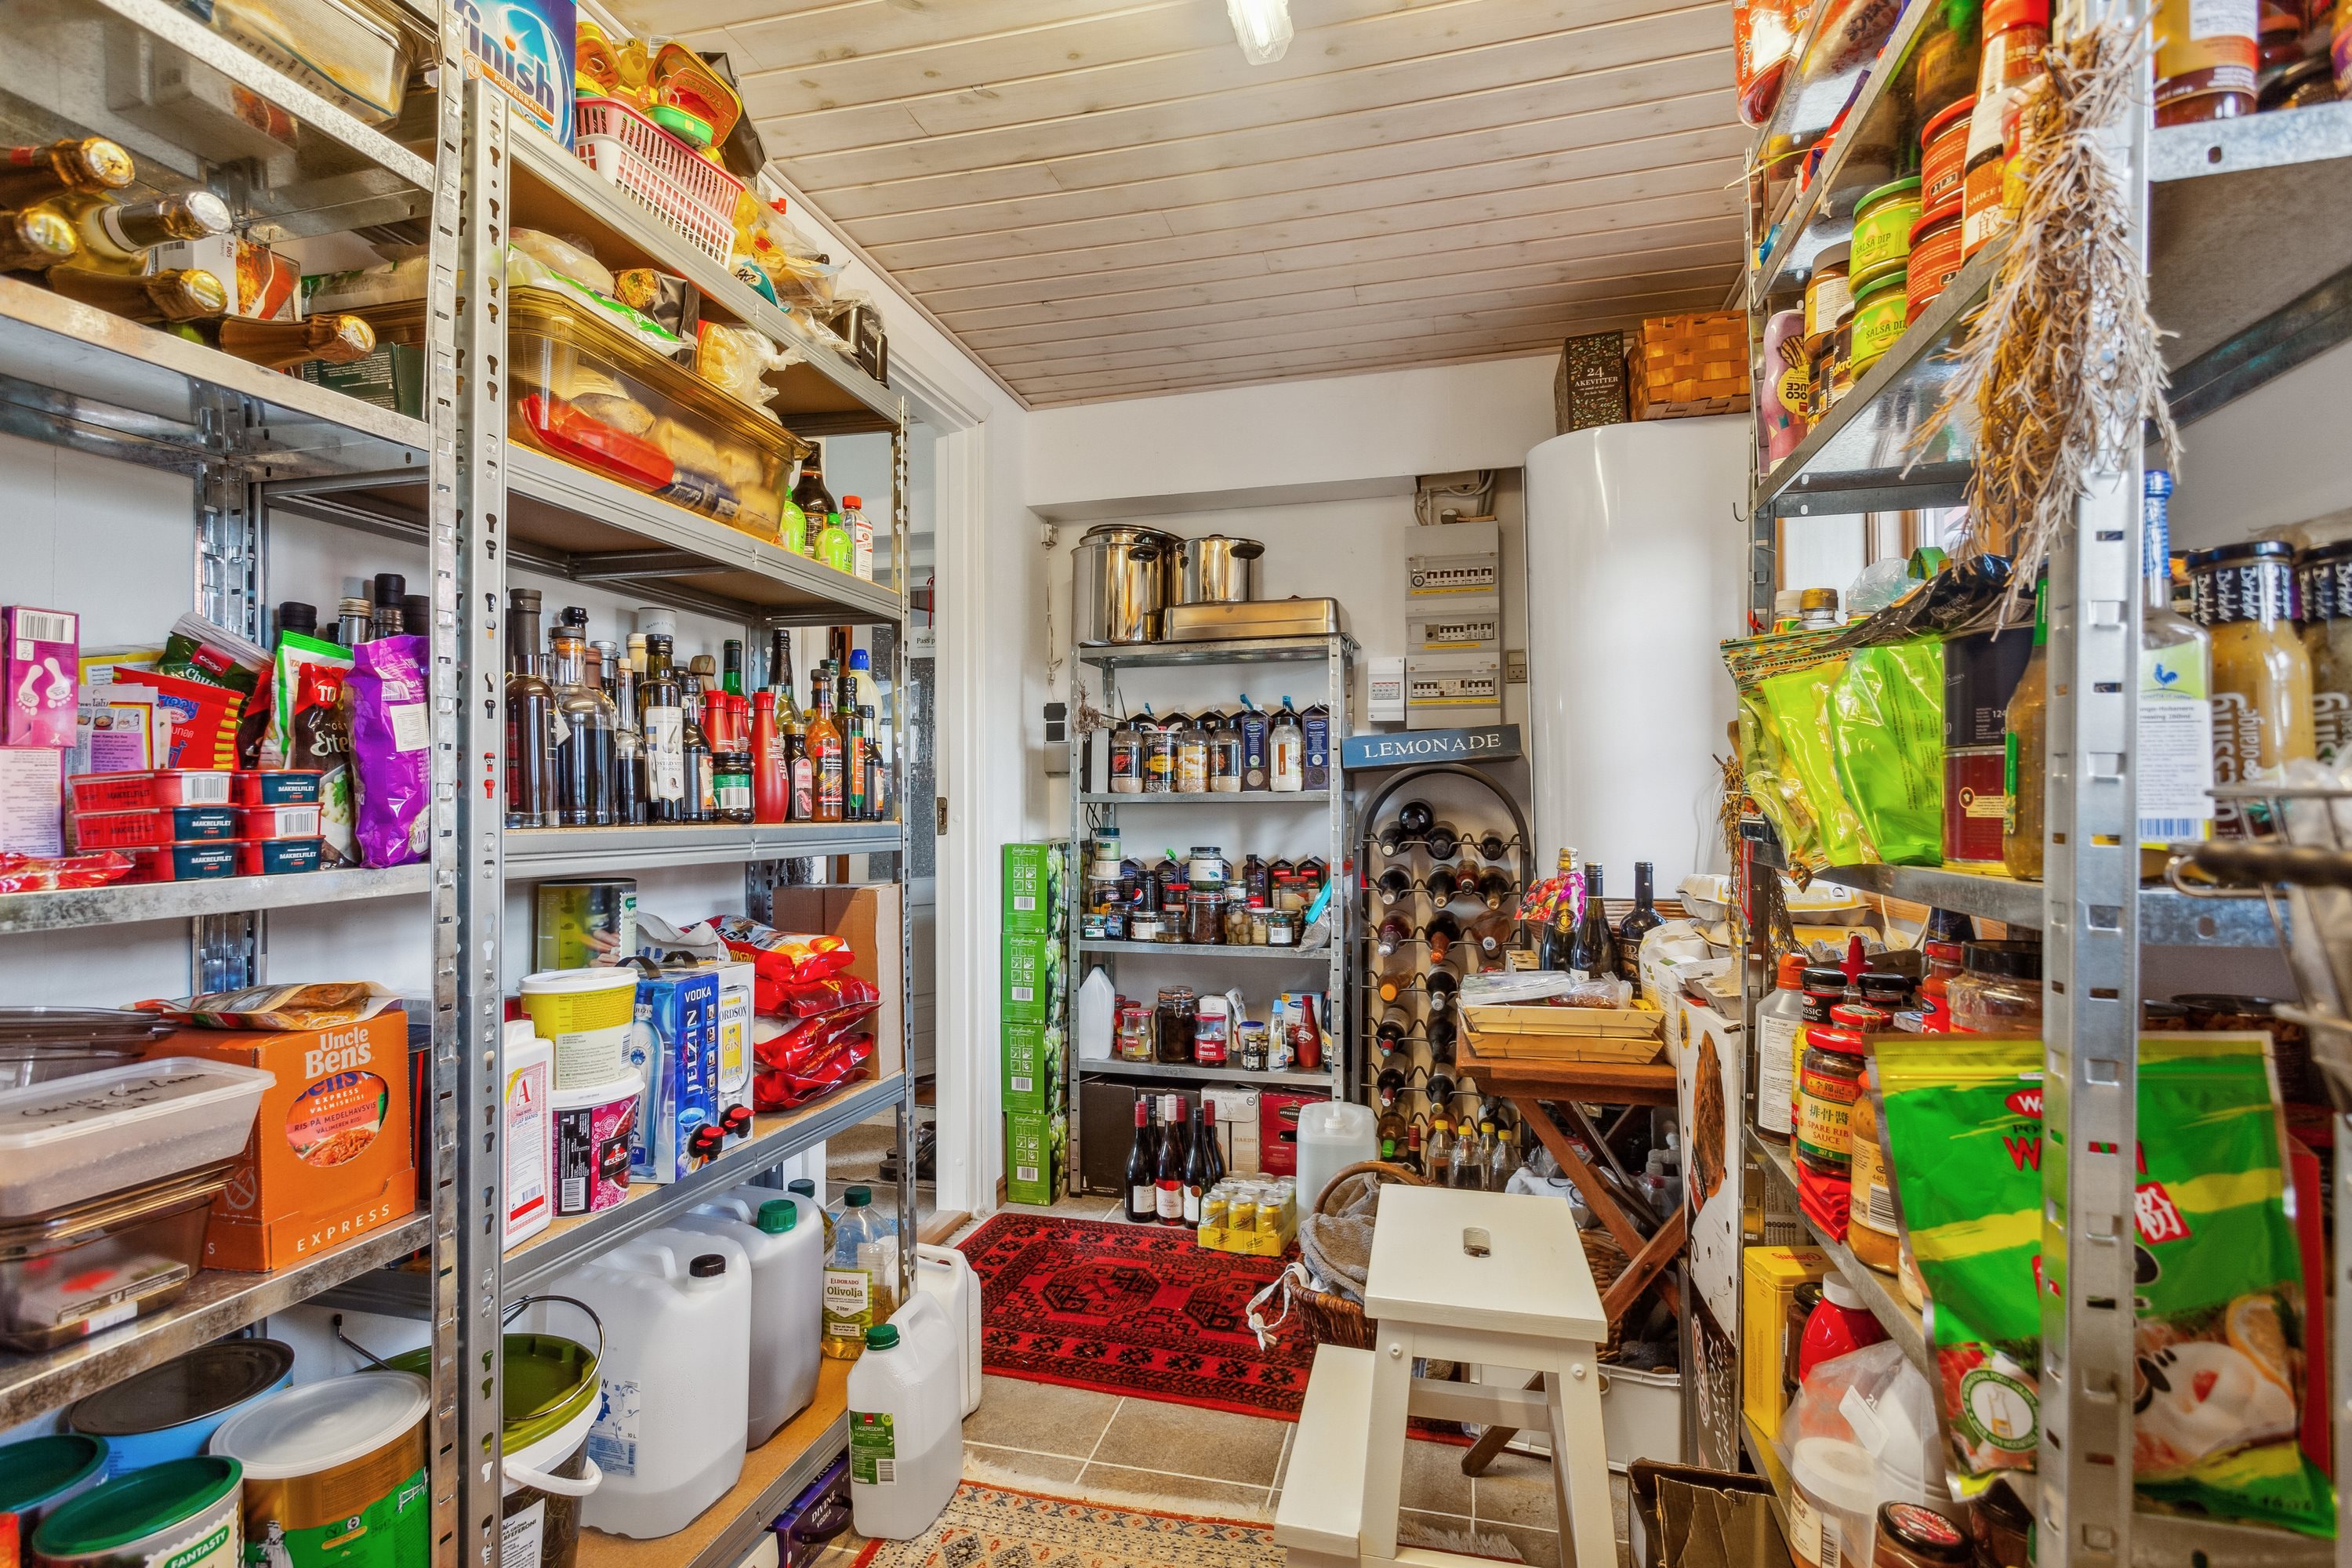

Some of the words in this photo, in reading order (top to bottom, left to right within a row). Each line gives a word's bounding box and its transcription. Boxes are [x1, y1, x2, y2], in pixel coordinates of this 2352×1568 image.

[463, 3, 555, 116] inish
[494, 74, 544, 118] POWERBALL
[677, 78, 724, 110] ANSJOVIS
[1968, 188, 1994, 207] SAUCE
[1857, 238, 1875, 254] SALSA
[1878, 233, 1891, 244] DIP
[1866, 324, 1890, 339] SALSA
[1574, 376, 1618, 387] AKEVITTER
[1587, 366, 1604, 378] 24
[198, 655, 222, 672] coop
[2238, 708, 2264, 758] orange
[1364, 734, 1501, 758] LEMONADE
[684, 986, 712, 1003] VODKA
[719, 1004, 747, 1022] ORDSON
[1803, 1007, 1830, 1016] ASSIC
[320, 1028, 368, 1052] Uncle
[724, 1040, 739, 1052] GIN
[687, 1009, 703, 1094] JELZIN
[315, 1088, 358, 1105] EXPRESS
[517, 1079, 531, 1106] A
[1815, 1080, 1845, 1095] 李錦記
[310, 1094, 364, 1113] VALMISRIISI
[294, 1122, 307, 1131] RIS
[310, 1118, 321, 1127] PÅ
[325, 1102, 376, 1123] MEDELHAVSVIS
[1809, 1104, 1849, 1126] 排骨醬
[1807, 1120, 1831, 1133] SPARE
[1833, 1127, 1849, 1138] RIB
[1813, 1132, 1840, 1145] SAUCE
[1872, 1174, 1884, 1183] 440
[297, 1204, 390, 1253] EXPRESS
[827, 1286, 863, 1298] Olivolja
[1714, 1340, 1731, 1472] ERRANO
[811, 1490, 836, 1523] DIVINE
[816, 1508, 832, 1528] VODKA
[171, 1530, 226, 1568] FANTASTY
